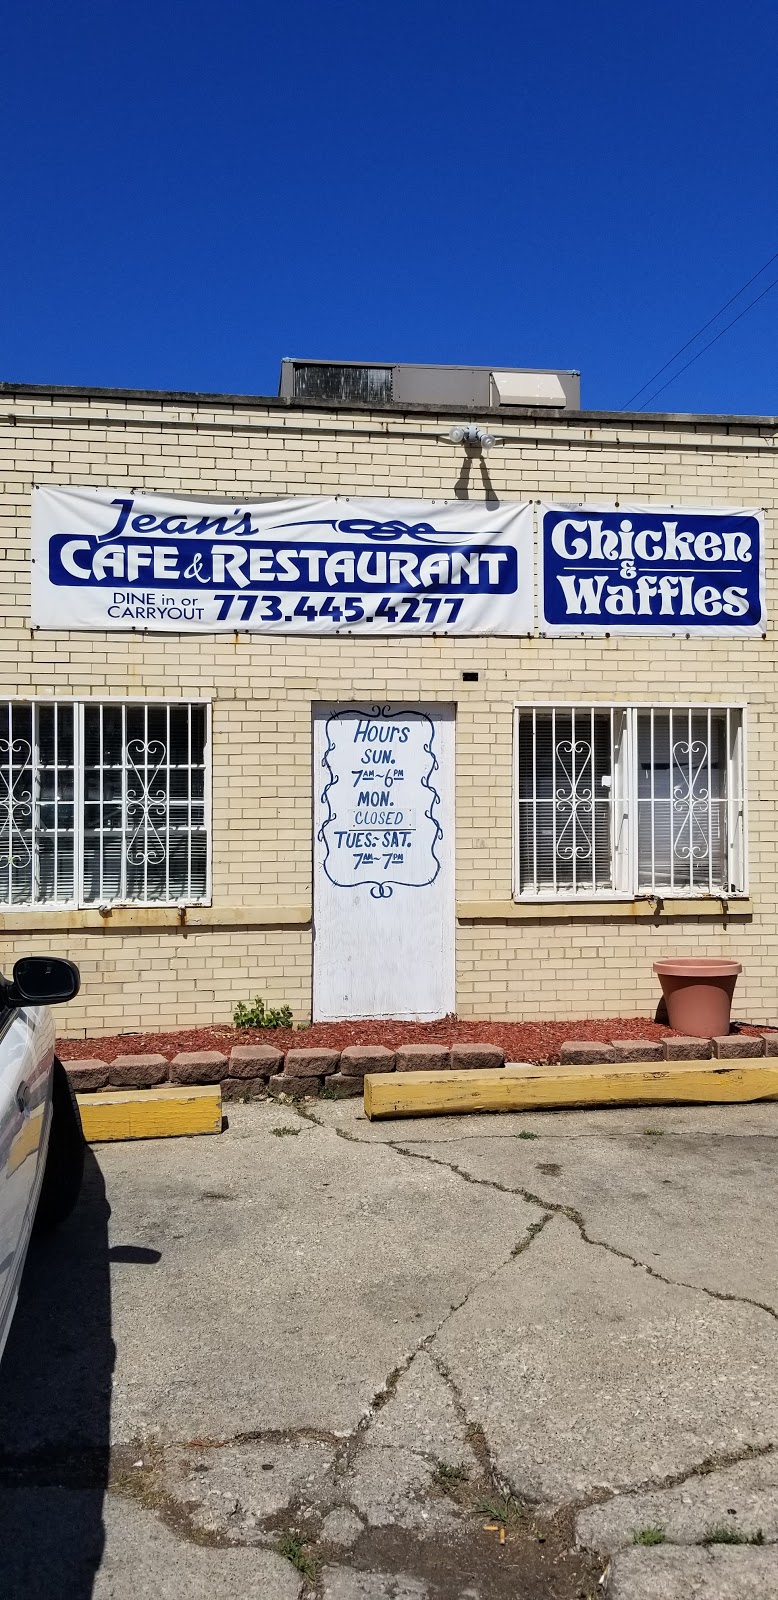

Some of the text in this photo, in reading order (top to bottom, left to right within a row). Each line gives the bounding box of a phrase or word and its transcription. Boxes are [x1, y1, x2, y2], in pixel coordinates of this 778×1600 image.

[98, 498, 260, 542] Jean's
[551, 519, 753, 563] Chicken
[60, 539, 508, 589] CAFE & RESTAURANT
[619, 560, 638, 580] &
[113, 592, 199, 606] DINE in or
[556, 575, 750, 617] Waffles
[107, 605, 205, 620] CARRYOUT
[213, 594, 465, 624] 773.445.4277
[360, 748, 396, 765] SUN.
[357, 790, 395, 807] MON.
[354, 810, 404, 825] CLOSED
